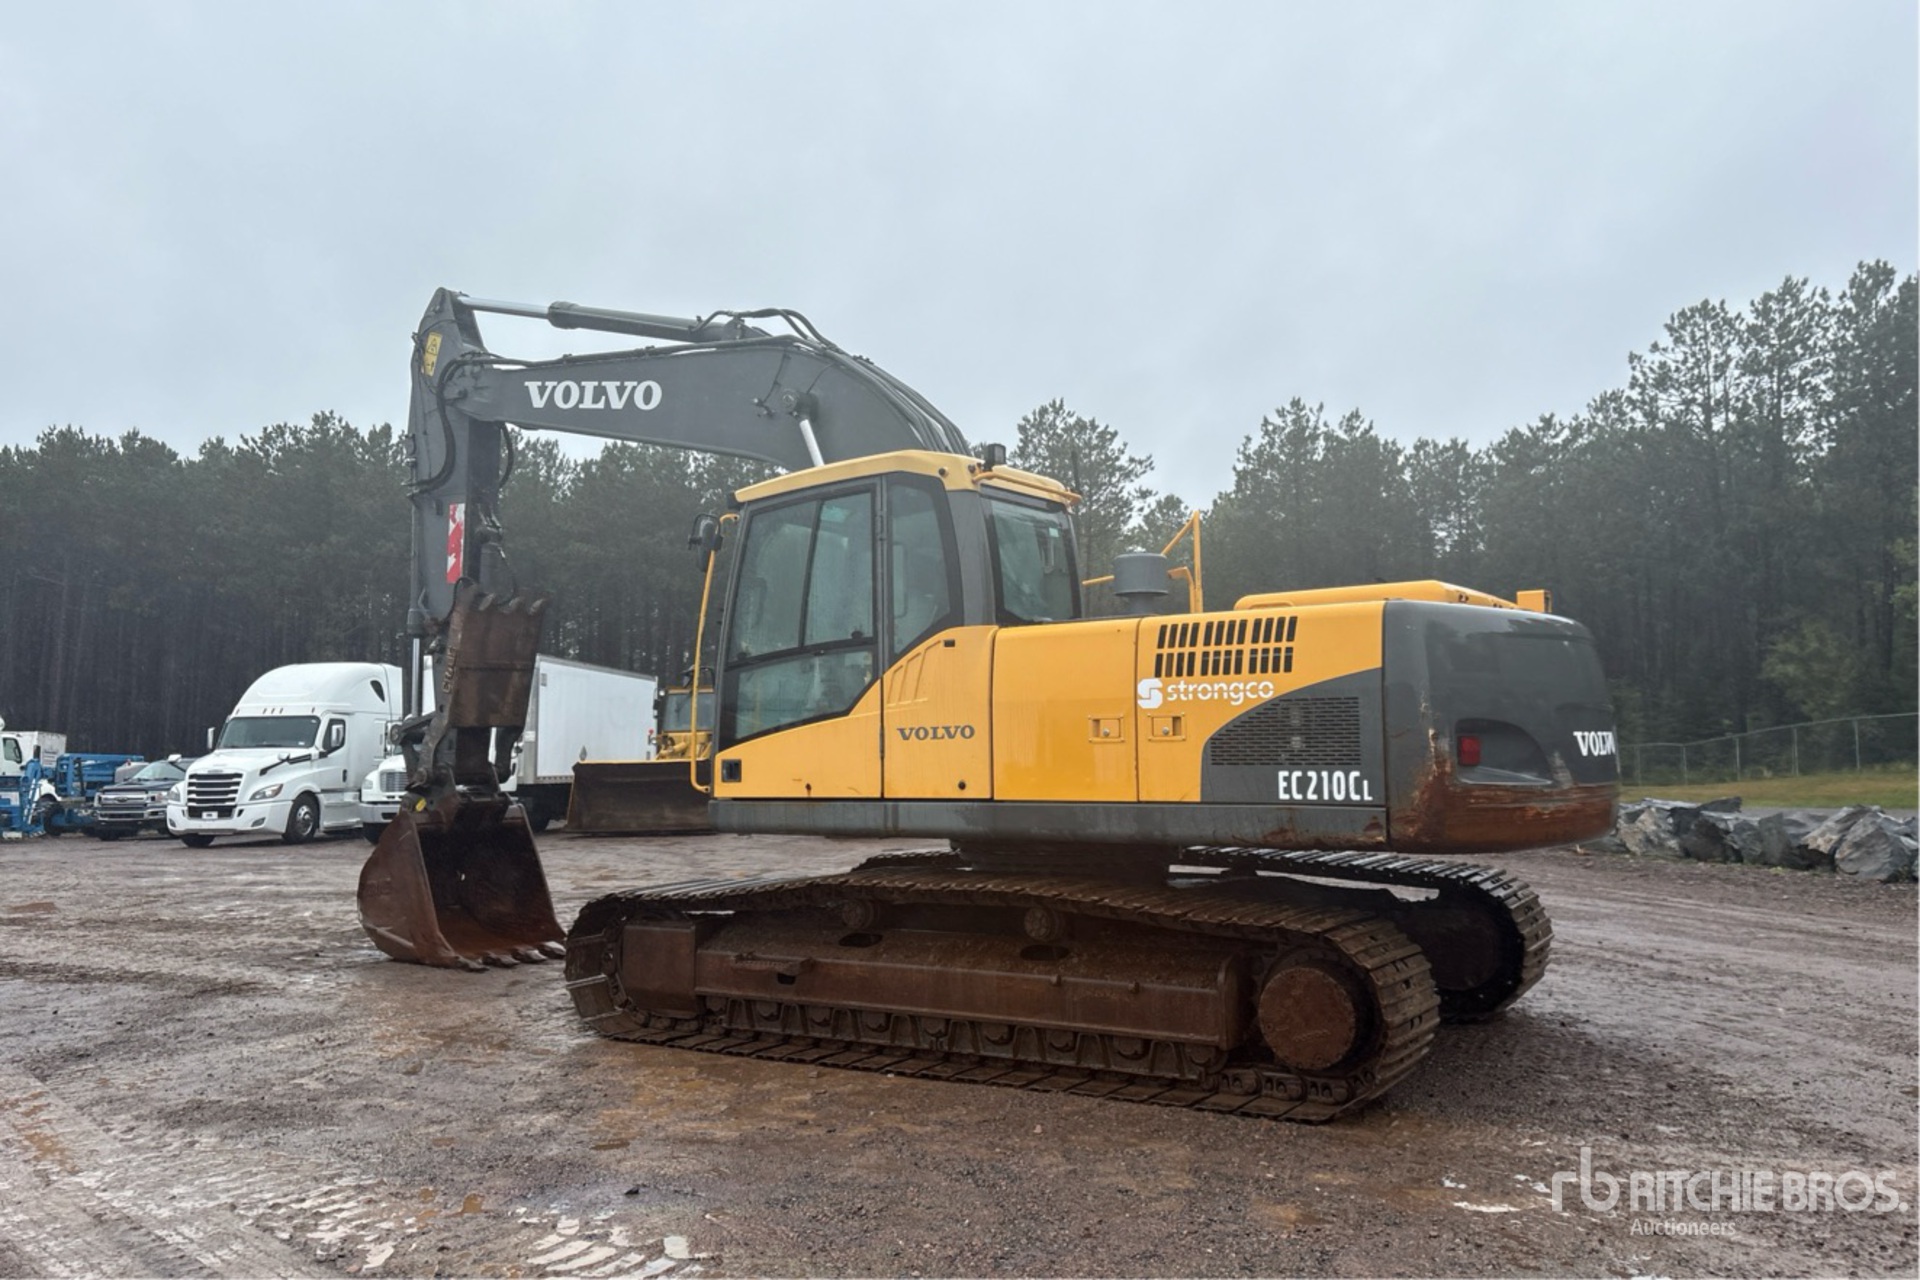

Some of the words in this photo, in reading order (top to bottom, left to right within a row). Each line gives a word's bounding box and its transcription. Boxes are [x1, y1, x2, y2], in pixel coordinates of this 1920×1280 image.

[524, 380, 662, 411] VOLVO
[1167, 680, 1274, 706] strongco
[897, 725, 975, 741] VOLVO
[1573, 731, 1616, 757] VOLV
